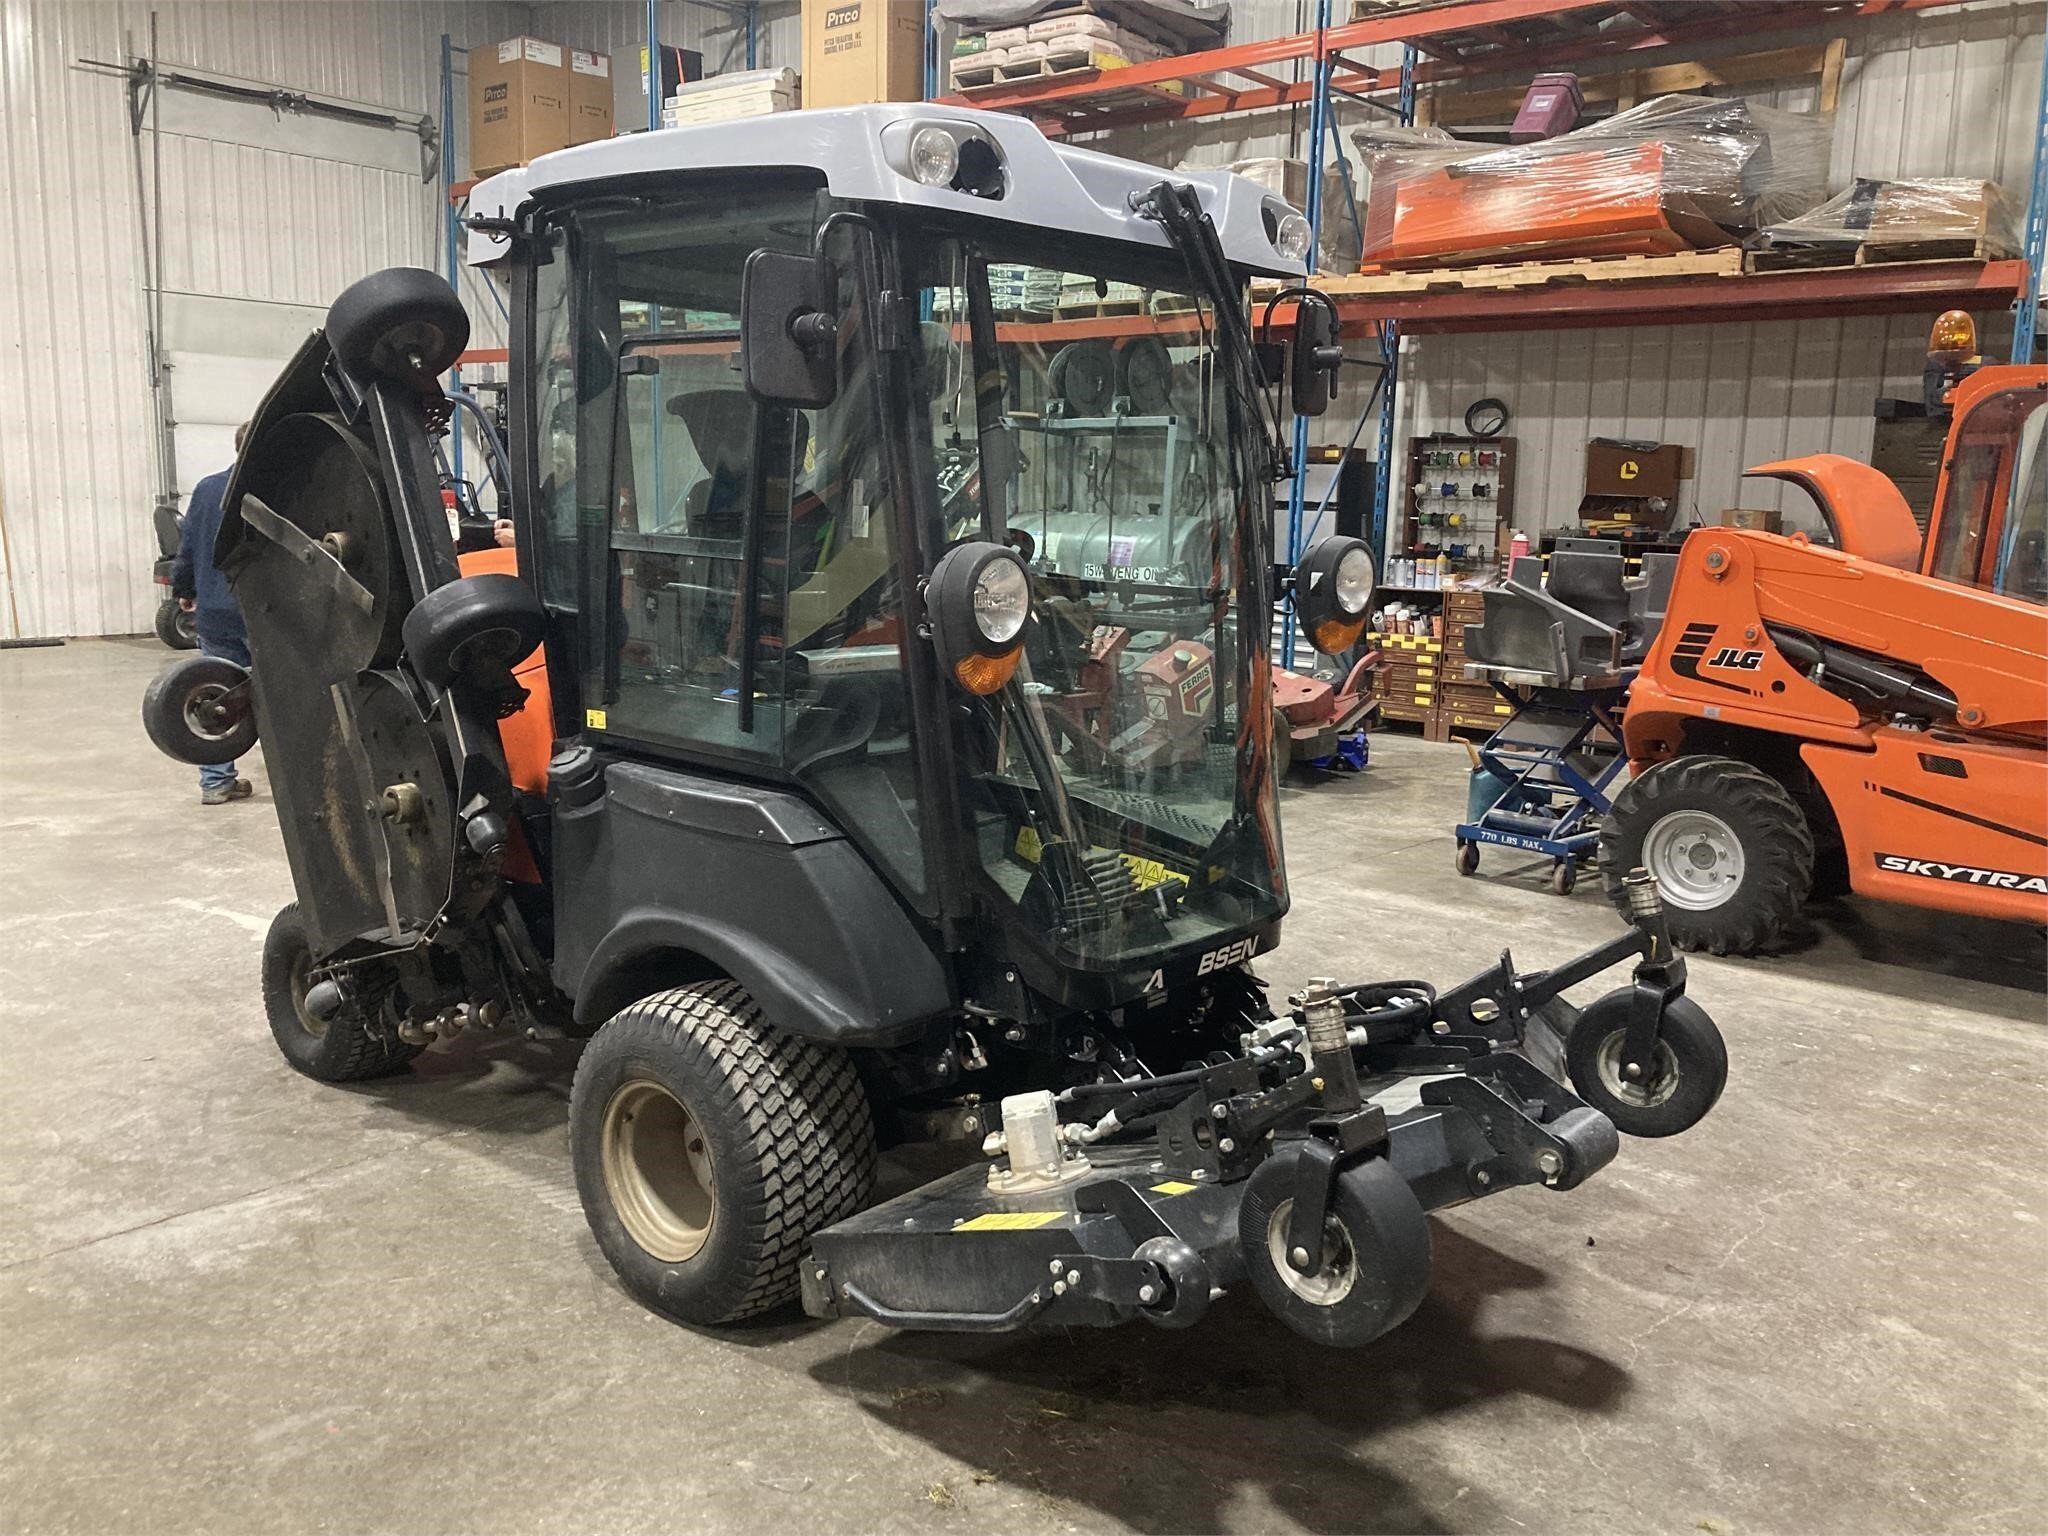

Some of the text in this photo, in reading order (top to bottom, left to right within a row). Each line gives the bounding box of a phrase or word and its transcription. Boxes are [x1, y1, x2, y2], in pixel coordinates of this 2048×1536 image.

[1707, 648, 1765, 670] JLG
[1180, 666, 1210, 693] FERRIS
[1480, 831, 1497, 841] 770
[1501, 835, 1518, 846] LBS
